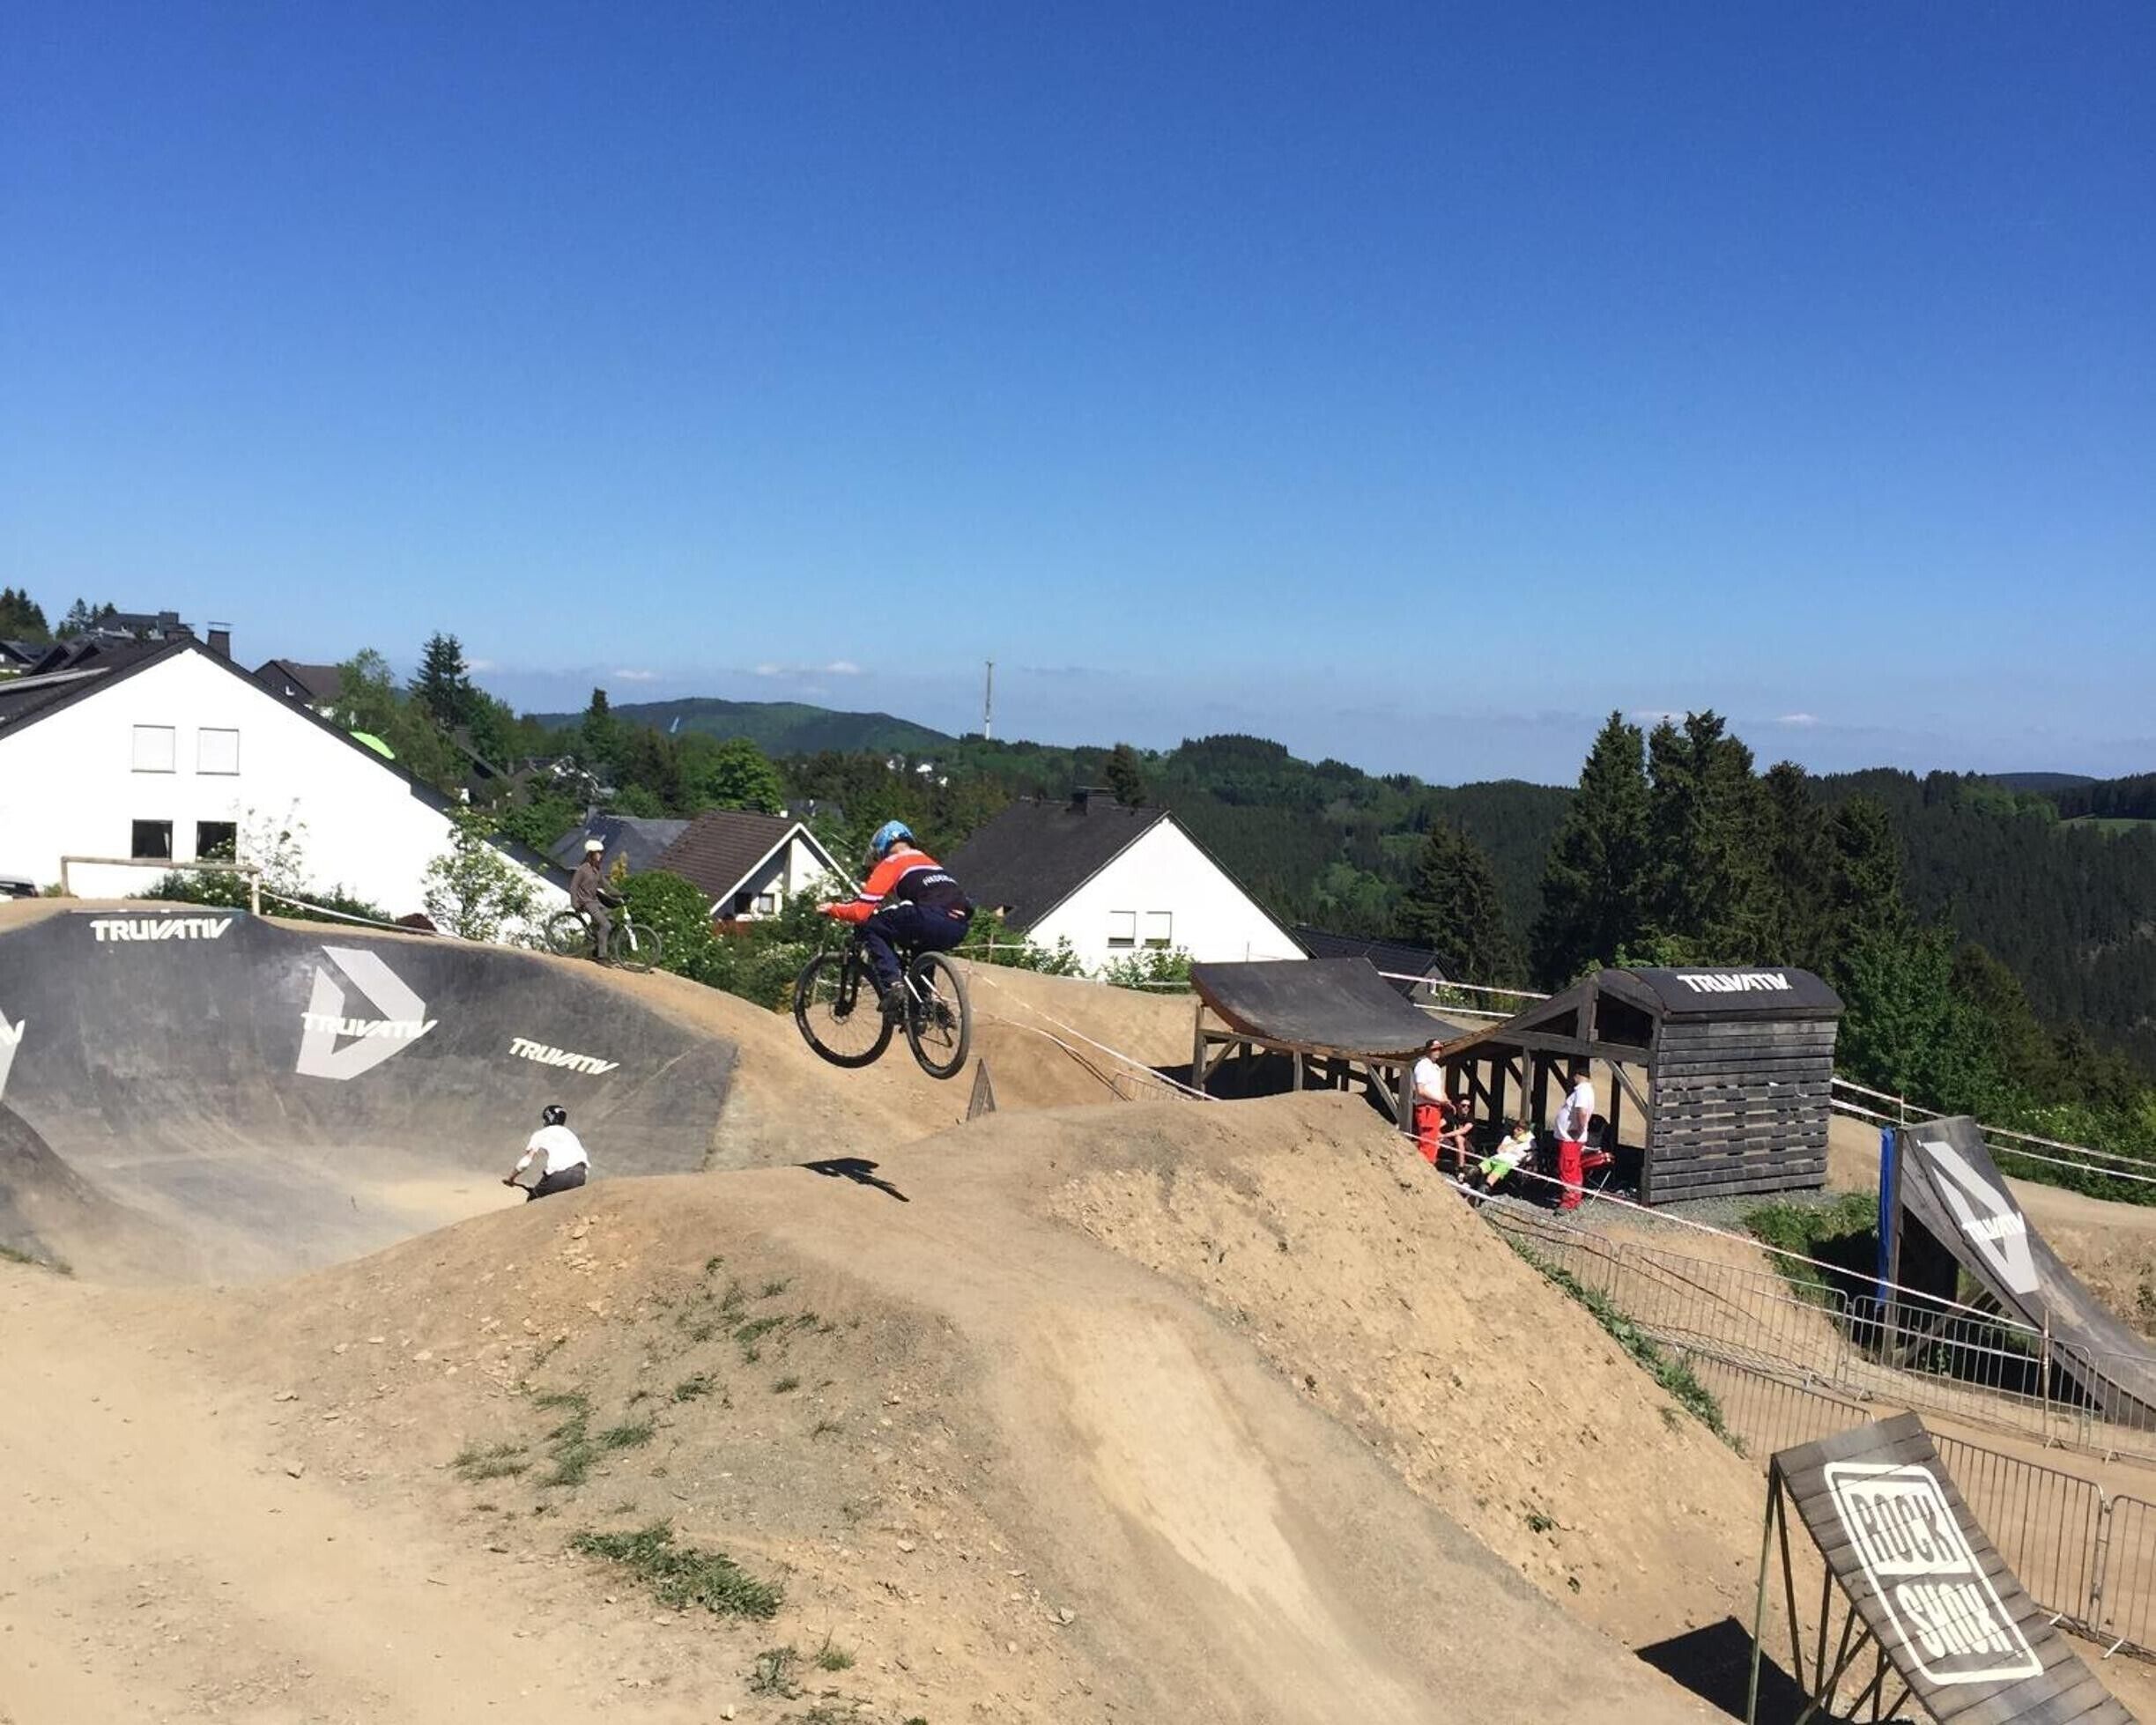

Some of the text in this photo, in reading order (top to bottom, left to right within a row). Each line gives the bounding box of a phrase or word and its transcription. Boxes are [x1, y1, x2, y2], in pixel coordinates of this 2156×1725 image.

[90, 918, 233, 942] TRUVATIV
[1677, 973, 1793, 993] TRUVATIV
[300, 1012, 438, 1039] TRUVATIV
[508, 1037, 619, 1075] TRUVATIV
[1850, 1493, 1960, 1564] ROCK
